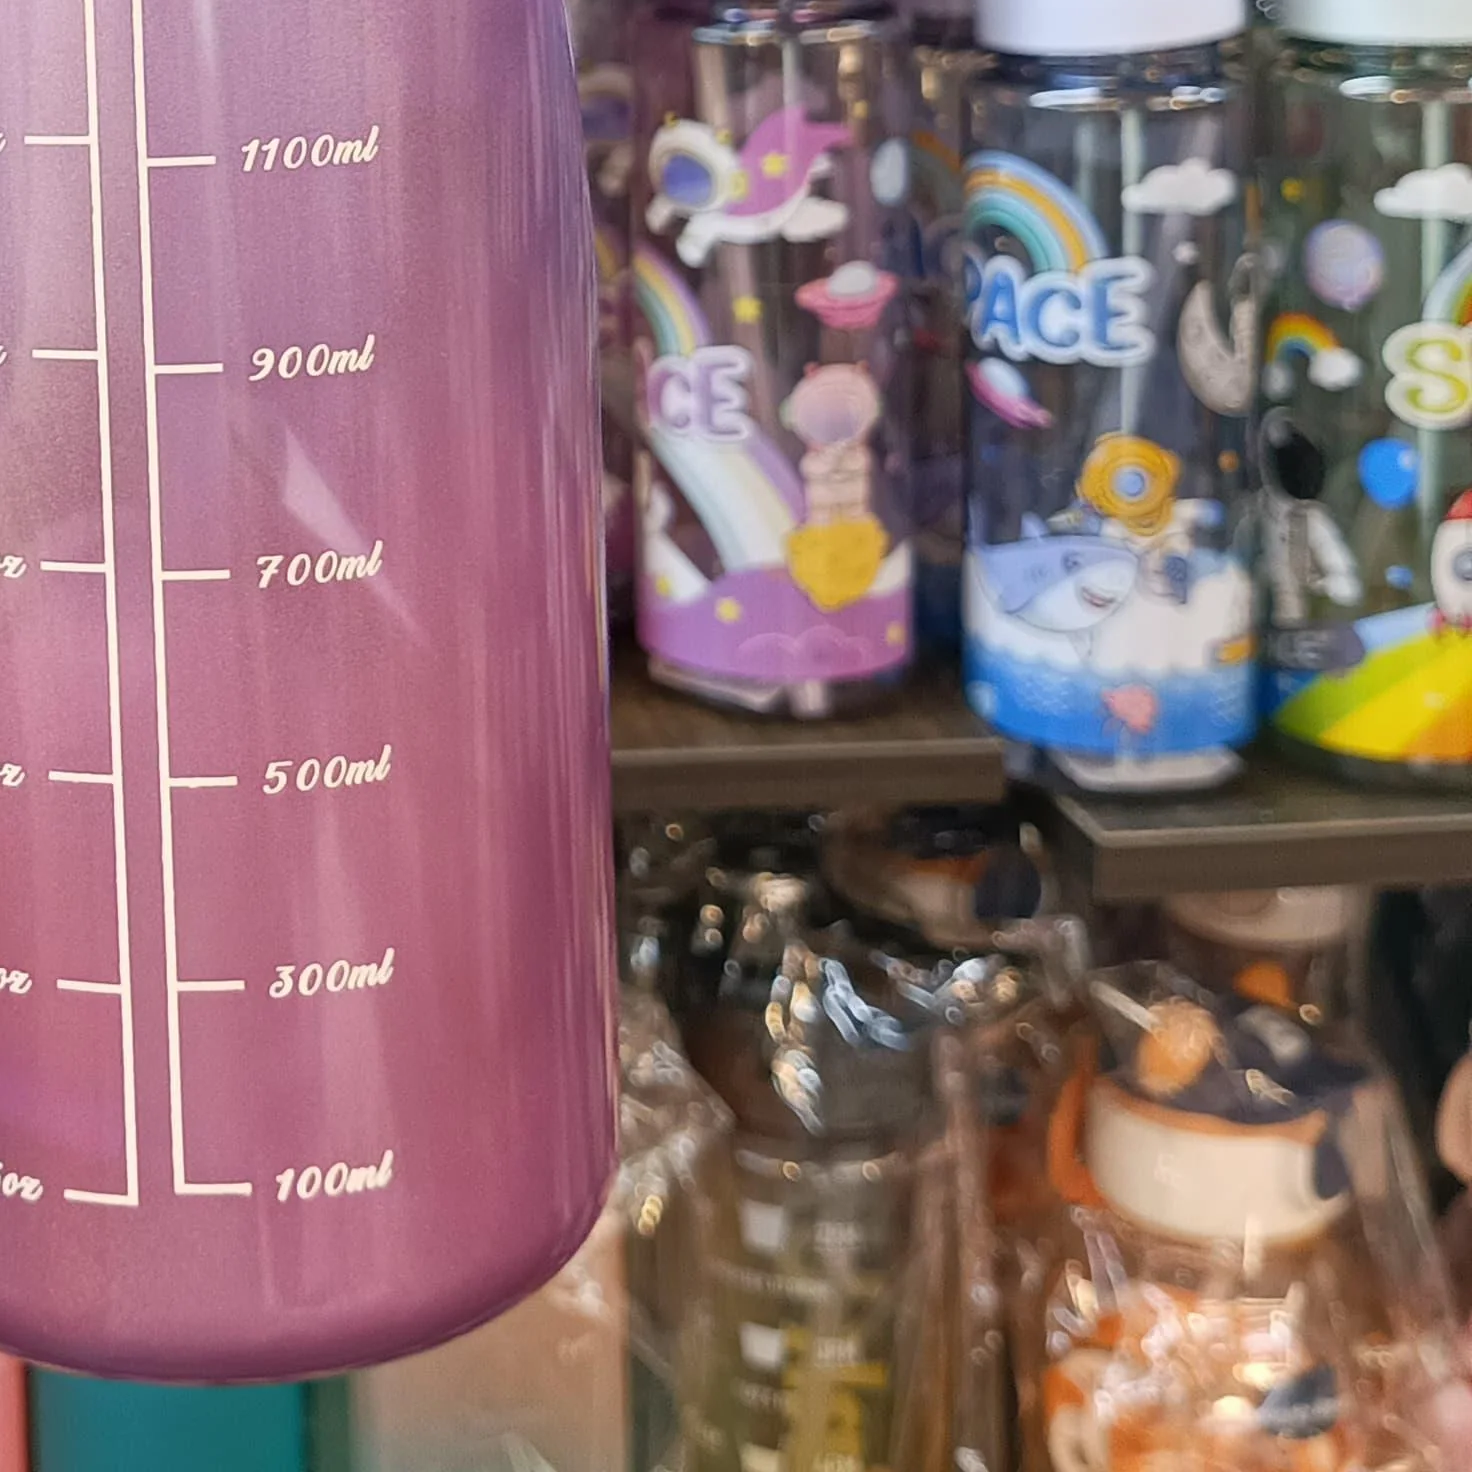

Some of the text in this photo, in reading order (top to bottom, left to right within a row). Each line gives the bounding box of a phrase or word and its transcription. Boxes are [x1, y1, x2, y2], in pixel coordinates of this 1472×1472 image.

[241, 125, 379, 172] 1100ml
[249, 334, 375, 381] 900ml
[256, 540, 383, 589] 700ml
[262, 744, 392, 794] 500ml
[269, 947, 395, 998] 300ml
[276, 1149, 394, 1202] 100ml
